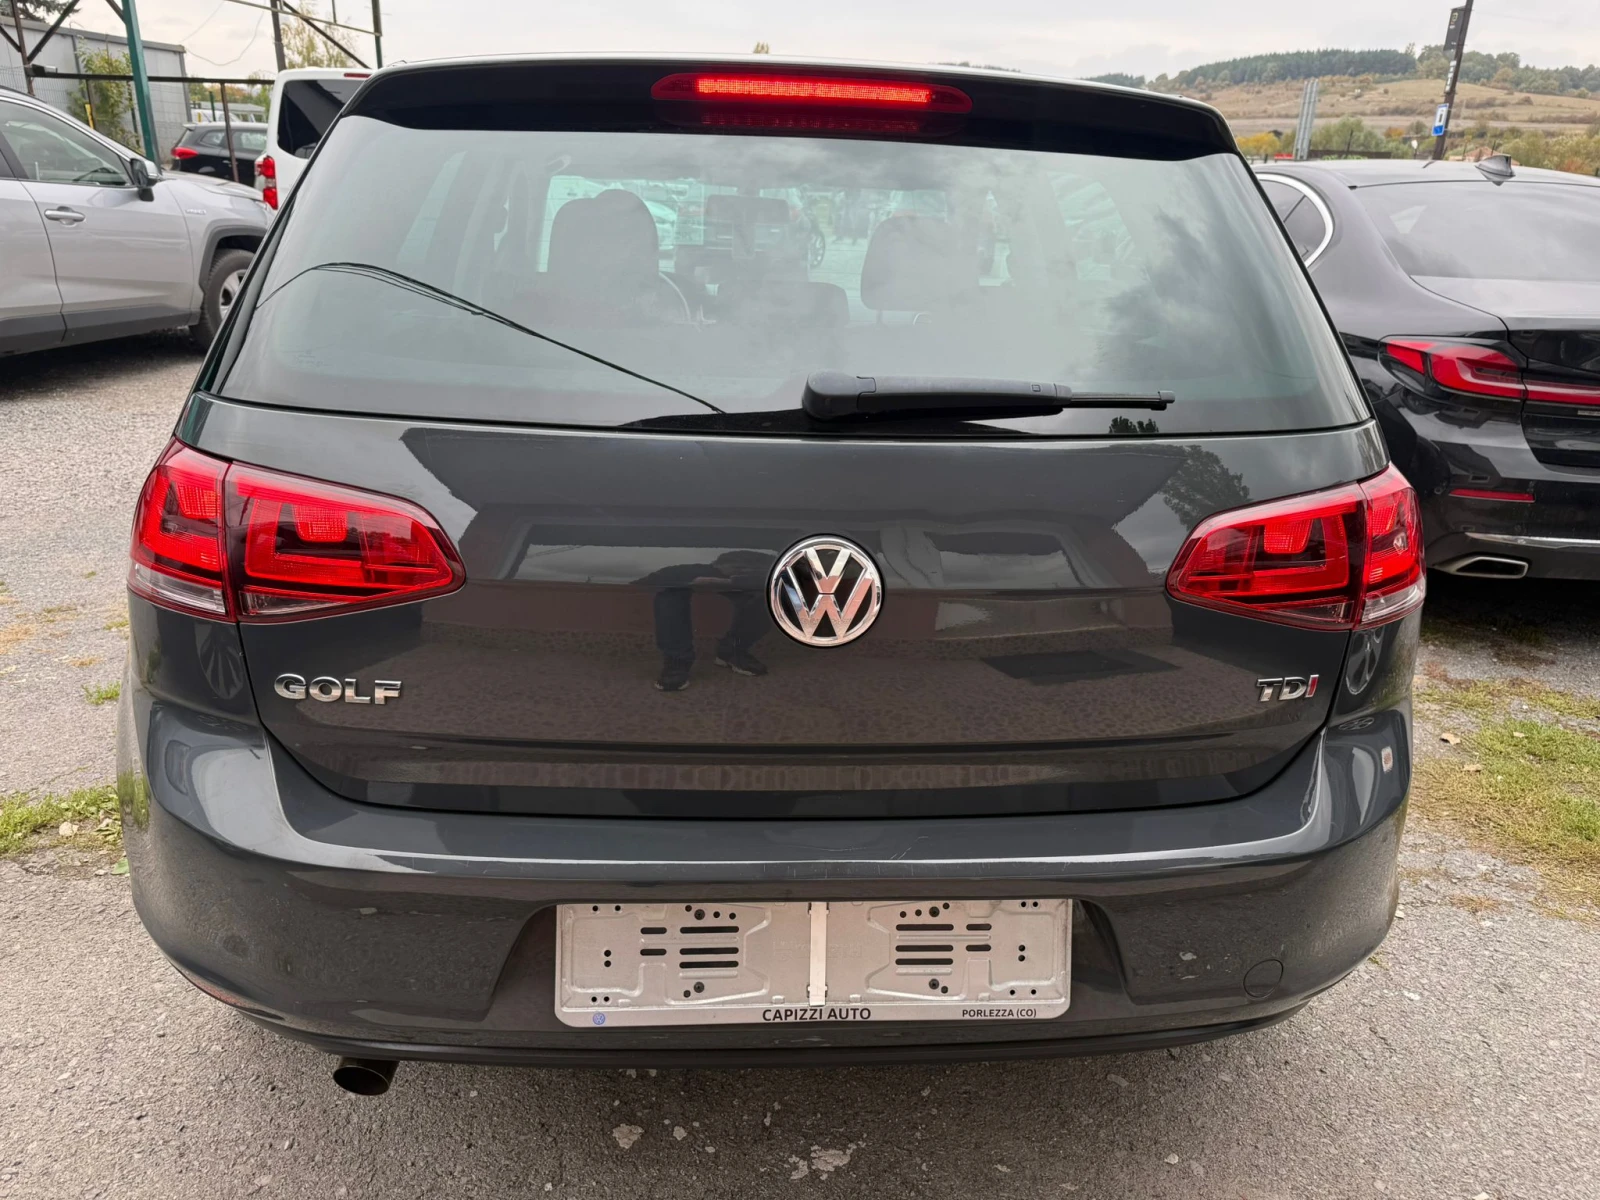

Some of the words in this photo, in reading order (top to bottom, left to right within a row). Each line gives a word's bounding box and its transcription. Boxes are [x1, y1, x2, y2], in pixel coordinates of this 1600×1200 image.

[274, 673, 402, 705] GOLF
[1256, 674, 1319, 702] TDI
[762, 1009, 823, 1021] CAPIZZI
[827, 1007, 872, 1020] AUTO
[962, 1009, 1015, 1018] PORLEZZA
[1016, 1008, 1037, 1018] (CO)
